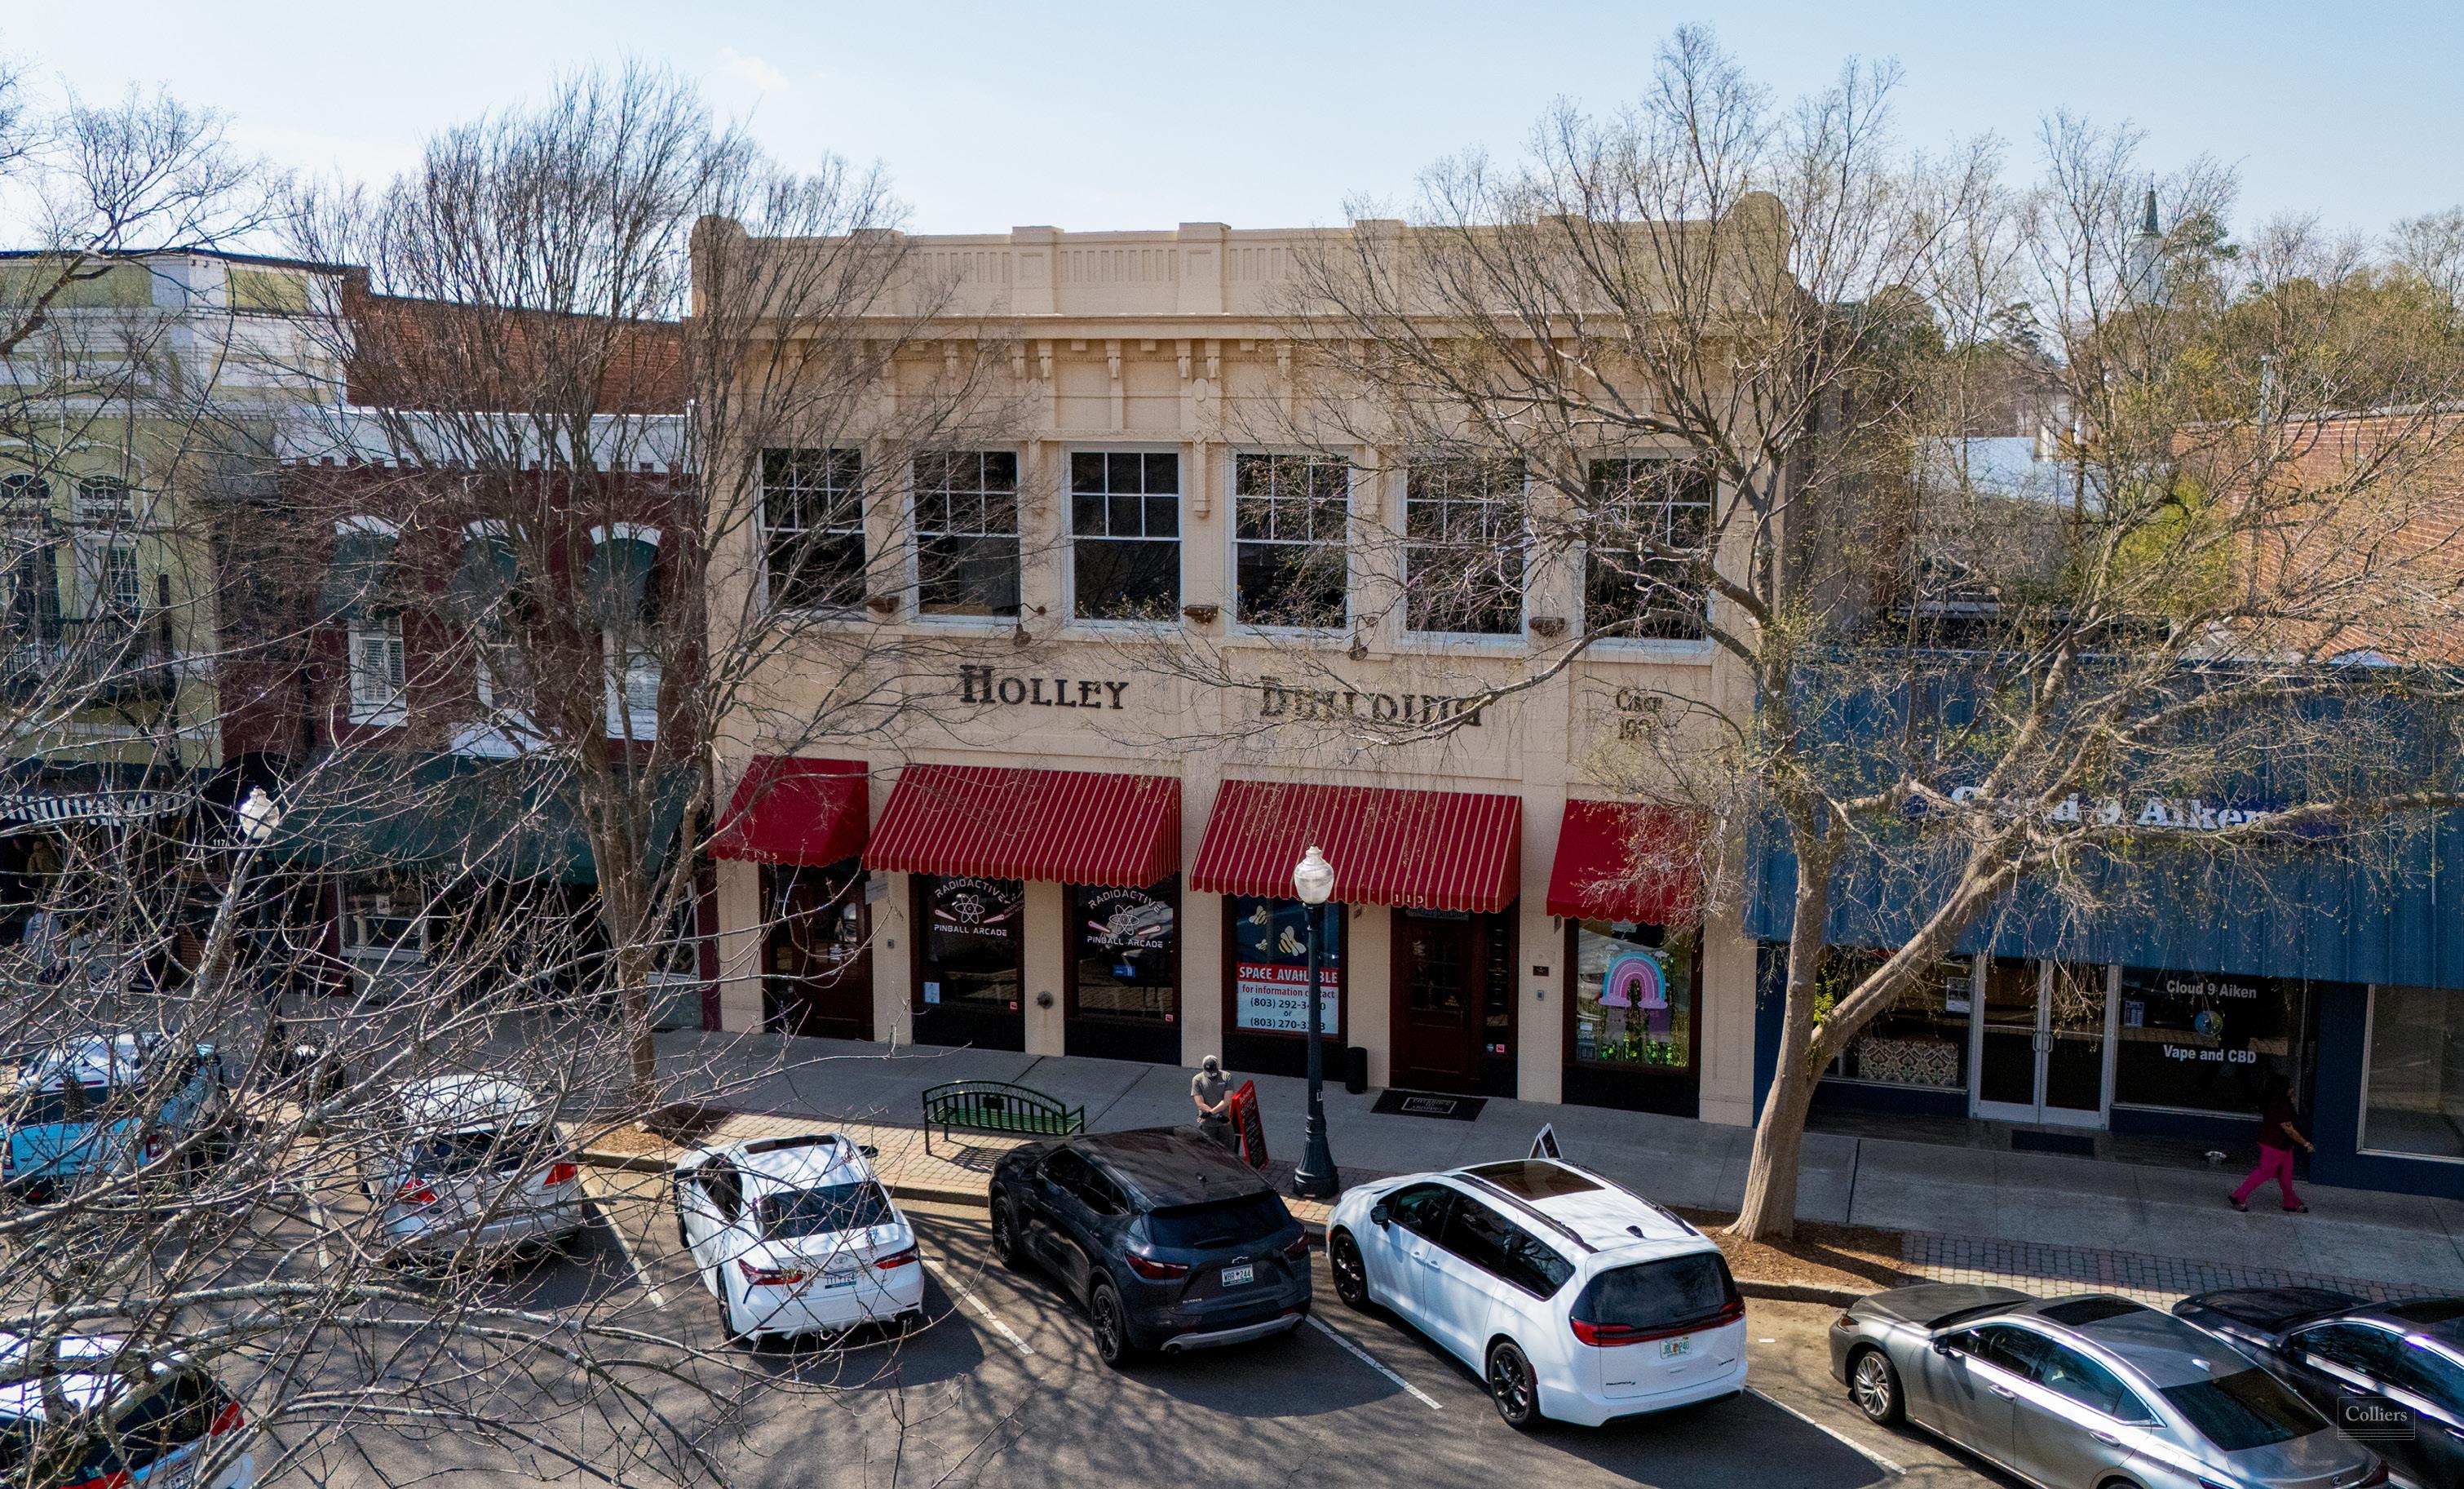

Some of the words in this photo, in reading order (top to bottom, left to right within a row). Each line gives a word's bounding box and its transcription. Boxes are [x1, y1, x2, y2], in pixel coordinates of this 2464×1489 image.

[959, 664, 1129, 710] HOLLEY
[935, 879, 1006, 902] RADIOACTIVE
[1088, 889, 1162, 915] RADIOACTIVE
[934, 924, 969, 933] PINBALL
[973, 927, 1007, 937] ARCADE
[1087, 936, 1123, 946] PINBALL
[1128, 939, 1163, 948] ARCADE
[1239, 967, 1272, 980] SPACE
[1277, 968, 1338, 983] AVAILBLE
[1242, 985, 1254, 993] for
[1255, 986, 1303, 996] information
[1304, 990, 1335, 999] cact
[2166, 980, 2203, 995] Cloud
[2207, 982, 2216, 995] 9
[2219, 984, 2257, 999] Aiken
[1250, 997, 1276, 1008] (803)
[1279, 999, 1326, 1011] 292-30
[1250, 1017, 1276, 1029] (803)
[2163, 1044, 2196, 1061] Vape
[2200, 1049, 2224, 1061] and
[2228, 1050, 2257, 1063] CBD
